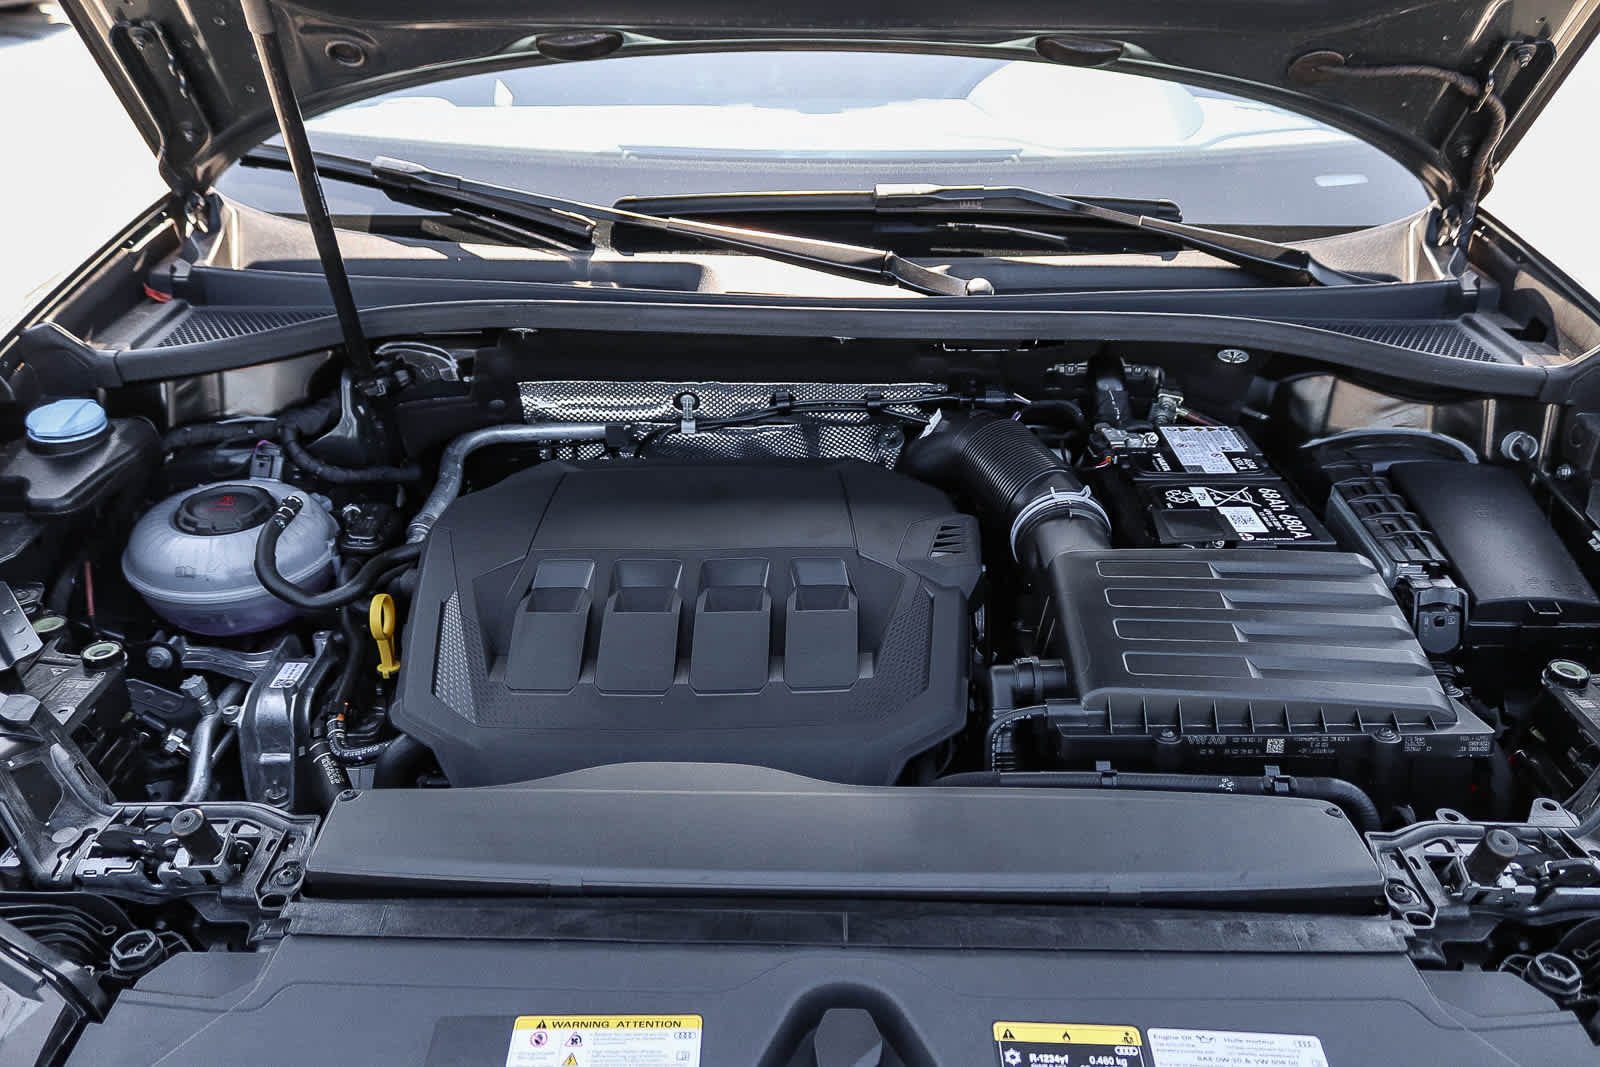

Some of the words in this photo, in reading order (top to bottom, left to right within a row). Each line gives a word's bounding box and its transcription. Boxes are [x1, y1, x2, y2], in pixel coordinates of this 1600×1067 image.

[1258, 487, 1290, 511] 68Ah
[1278, 514, 1312, 539] 680A
[552, 1020, 610, 1029] WARNING
[616, 1020, 682, 1029] ATTENTION
